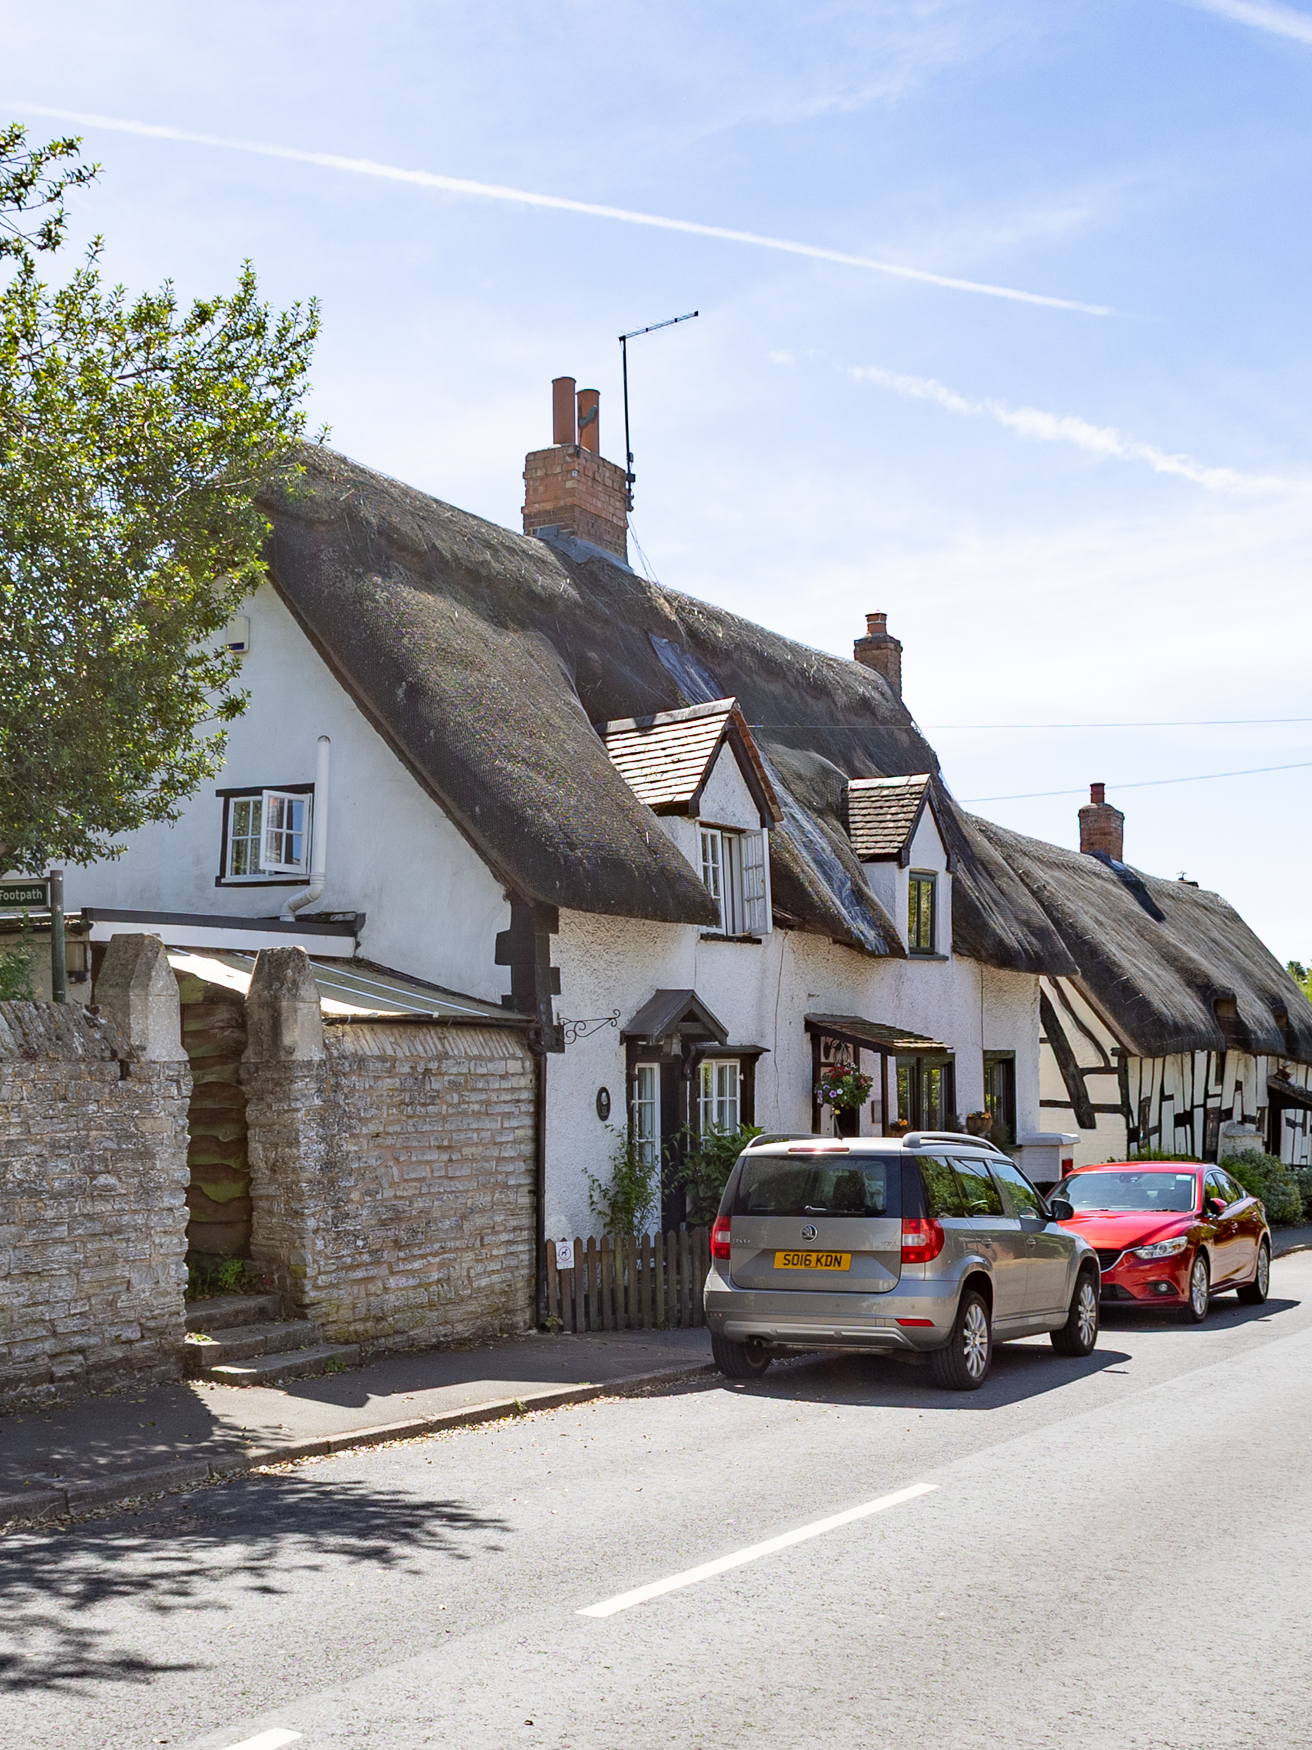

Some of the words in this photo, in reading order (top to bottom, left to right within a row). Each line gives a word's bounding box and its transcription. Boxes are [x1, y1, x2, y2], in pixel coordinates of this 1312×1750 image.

[0, 889, 43, 902] Footpath
[782, 1253, 813, 1267] SO16
[815, 1254, 843, 1268] KDN
